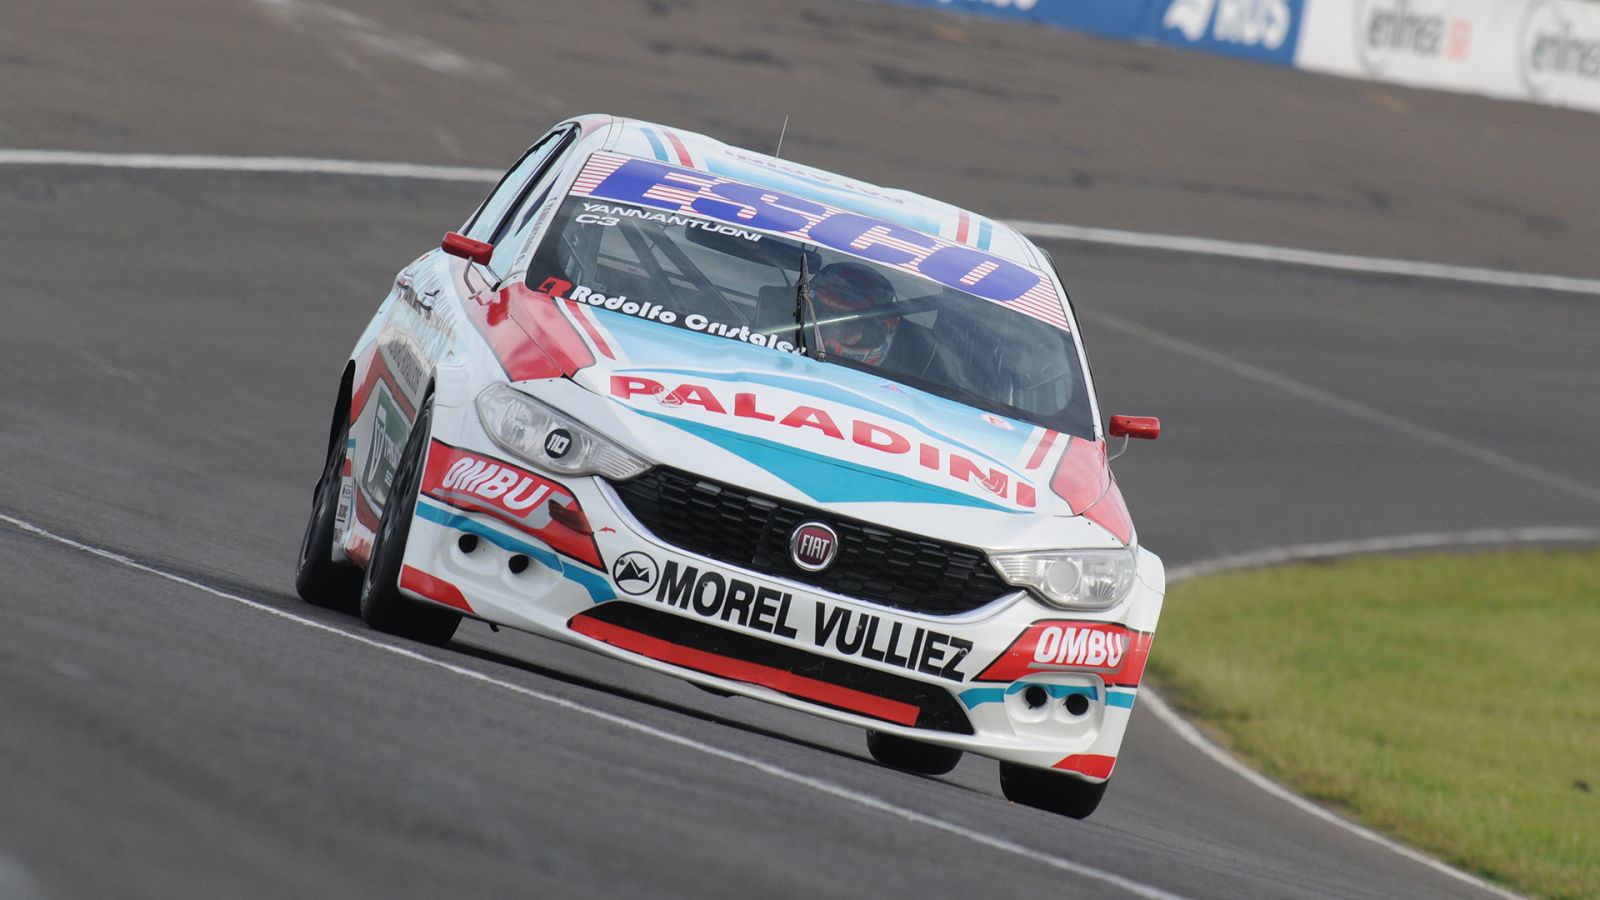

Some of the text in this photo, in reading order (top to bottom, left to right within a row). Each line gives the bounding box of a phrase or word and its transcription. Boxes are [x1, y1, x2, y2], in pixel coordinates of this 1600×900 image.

[575, 214, 621, 227] C3
[582, 203, 763, 243] YANNANTUONI
[589, 158, 1042, 302] ESCO
[569, 285, 677, 324] Rodolfo
[610, 375, 1037, 508] PALADINI
[442, 457, 549, 510] OMBU
[800, 534, 830, 560] FIAT
[655, 559, 974, 683] MOREL VULLIEZ
[1034, 626, 1123, 668] OMBU
